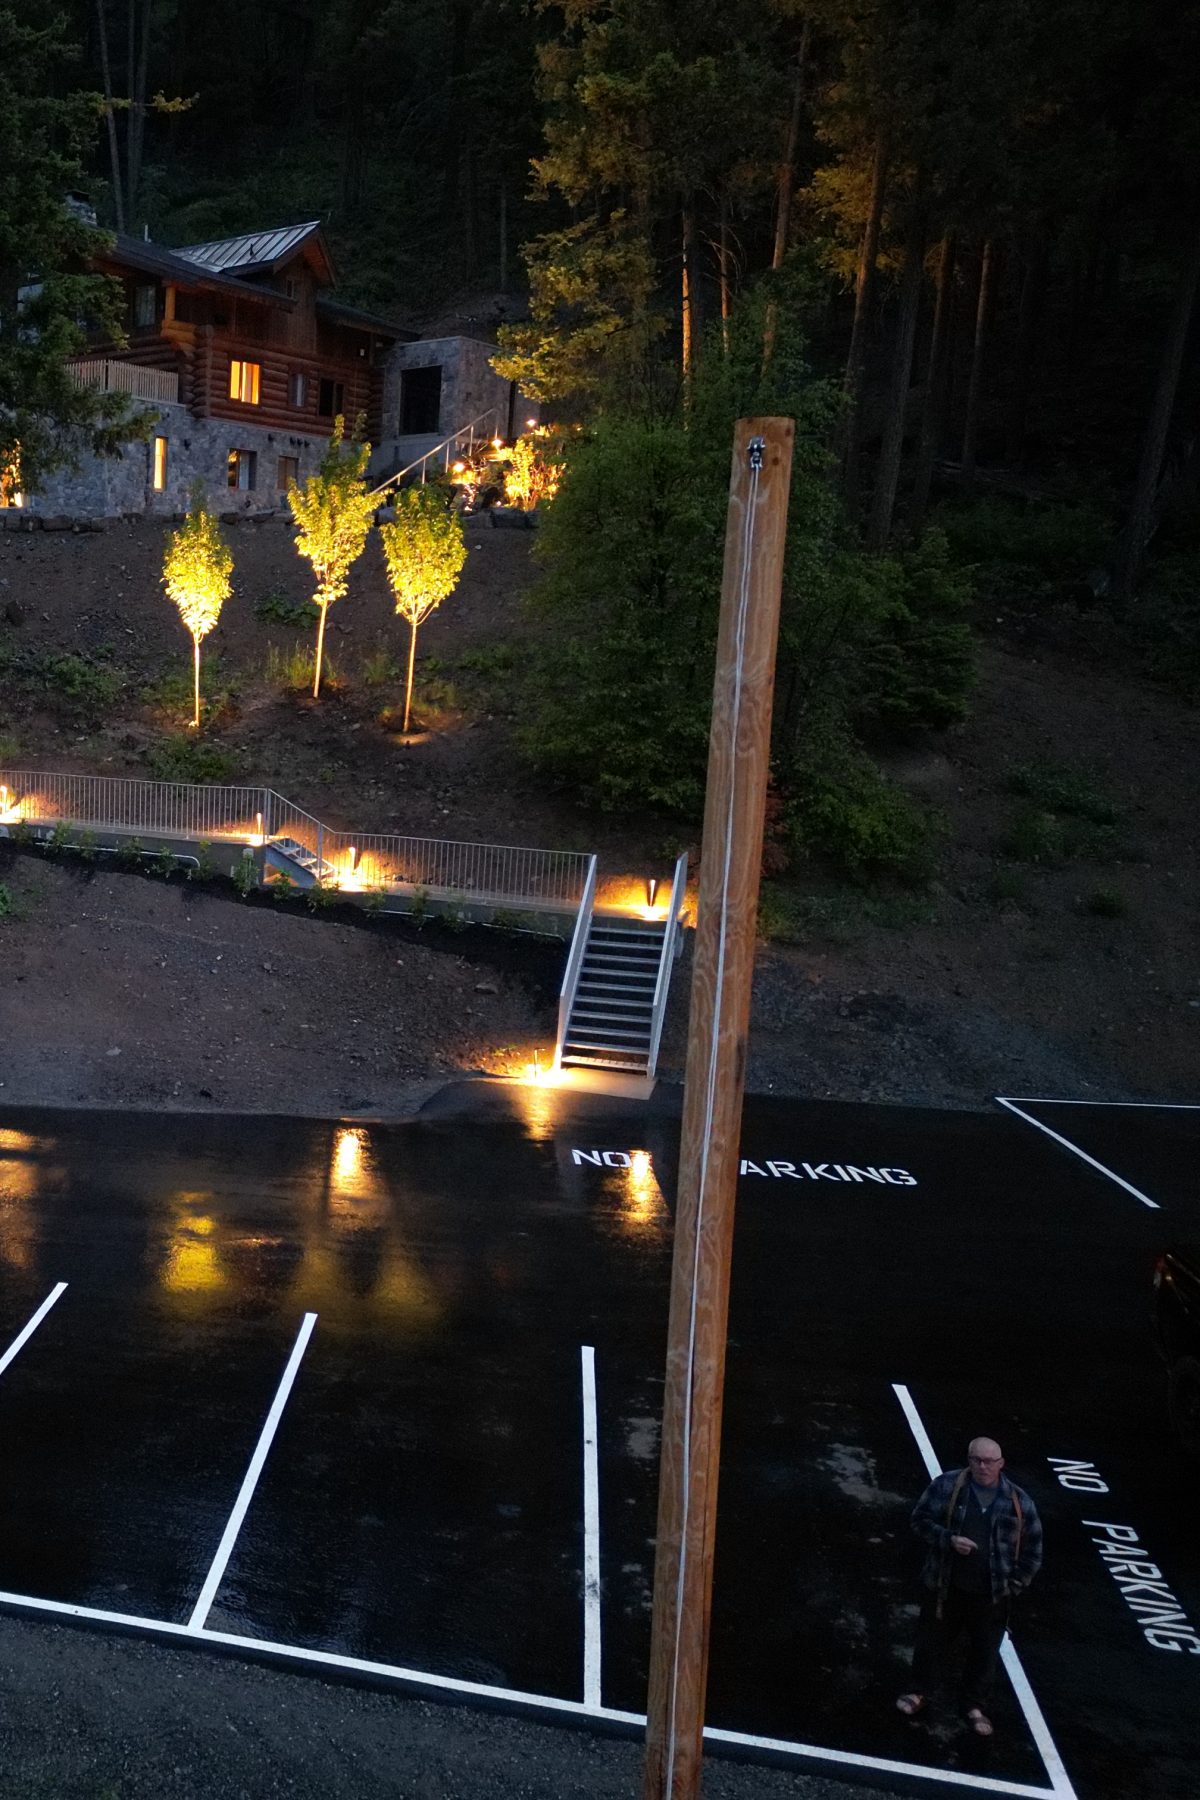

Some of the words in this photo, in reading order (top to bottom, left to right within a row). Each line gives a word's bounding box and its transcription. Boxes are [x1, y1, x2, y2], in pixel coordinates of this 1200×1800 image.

[571, 1148, 632, 1168] NO
[739, 1159, 918, 1186] ARKING
[1046, 1457, 1110, 1493] NO
[1081, 1519, 1200, 1654] PARKING
